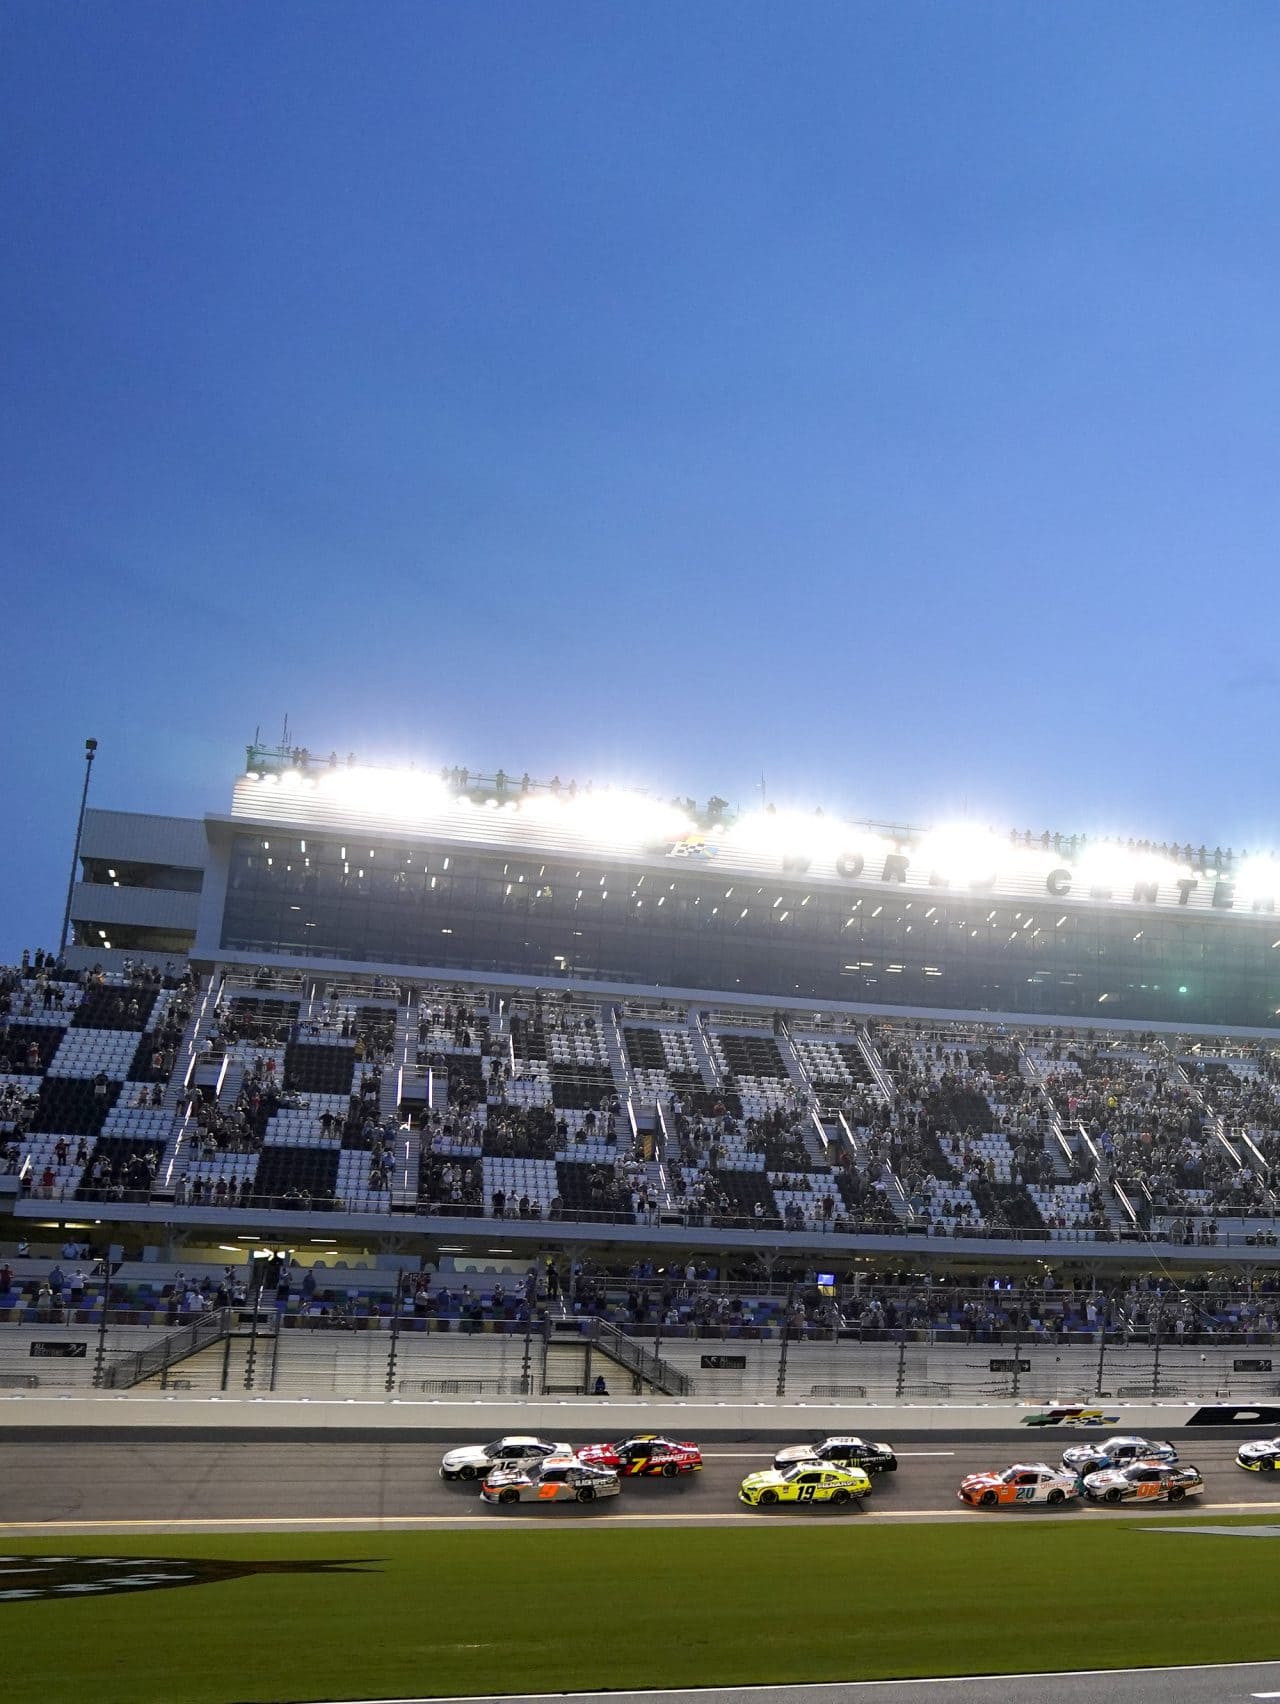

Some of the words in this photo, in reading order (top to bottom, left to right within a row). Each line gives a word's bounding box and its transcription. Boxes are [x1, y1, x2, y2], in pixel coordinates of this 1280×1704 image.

[631, 1458, 648, 1473] 7
[797, 1485, 817, 1500] 19
[1016, 1487, 1036, 1500] 20
